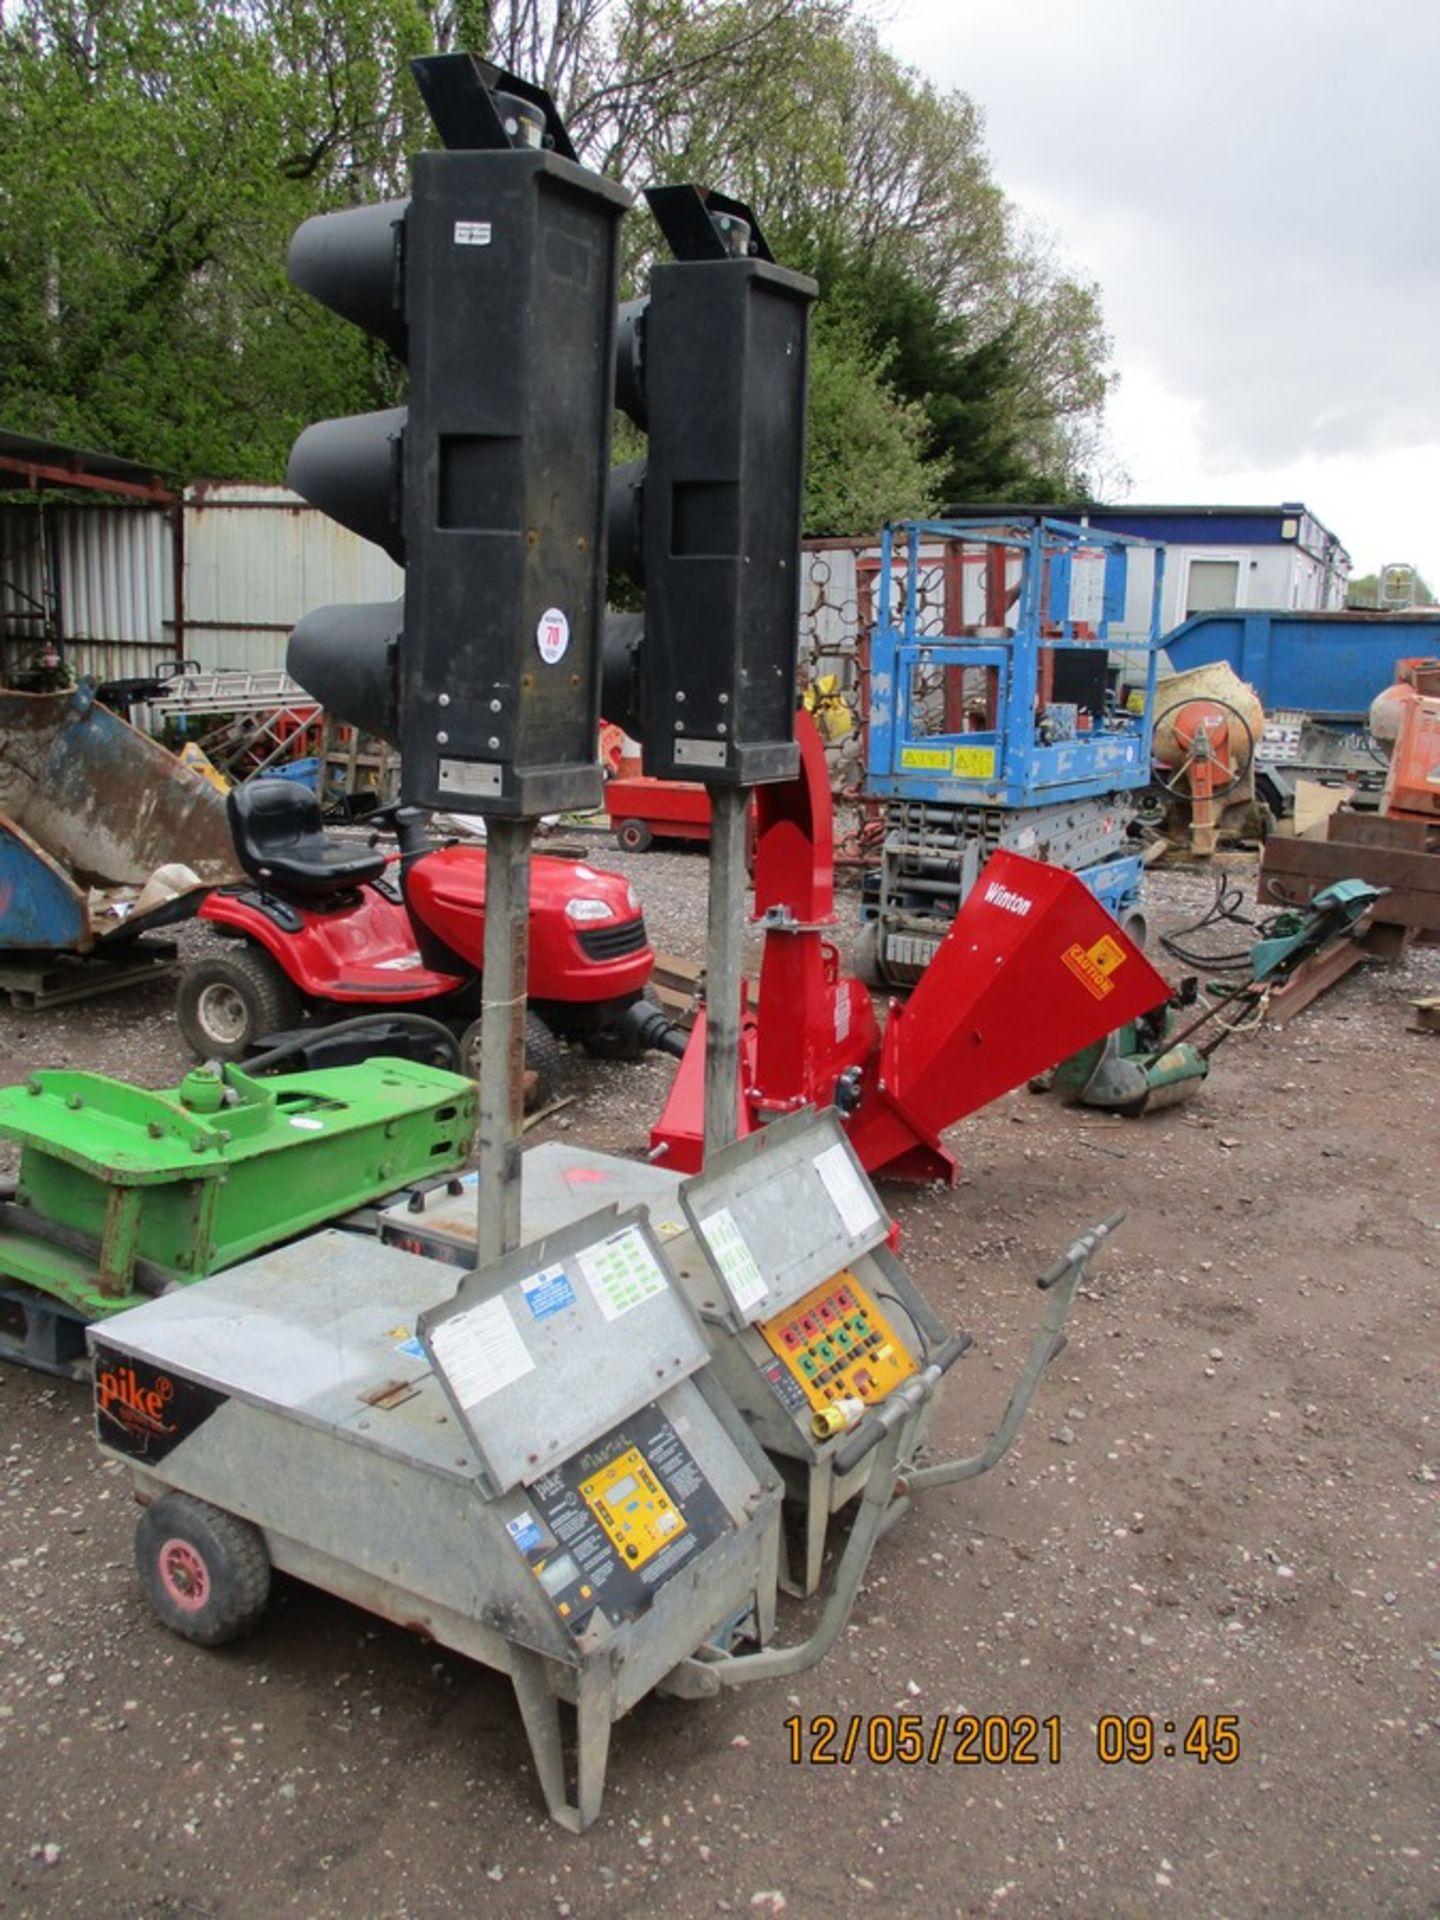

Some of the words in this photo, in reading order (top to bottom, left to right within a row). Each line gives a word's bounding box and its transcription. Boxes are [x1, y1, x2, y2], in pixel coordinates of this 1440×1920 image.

[546, 626, 561, 645] 70
[984, 882, 1032, 916] Winton
[1069, 946, 1111, 993] CAUTION
